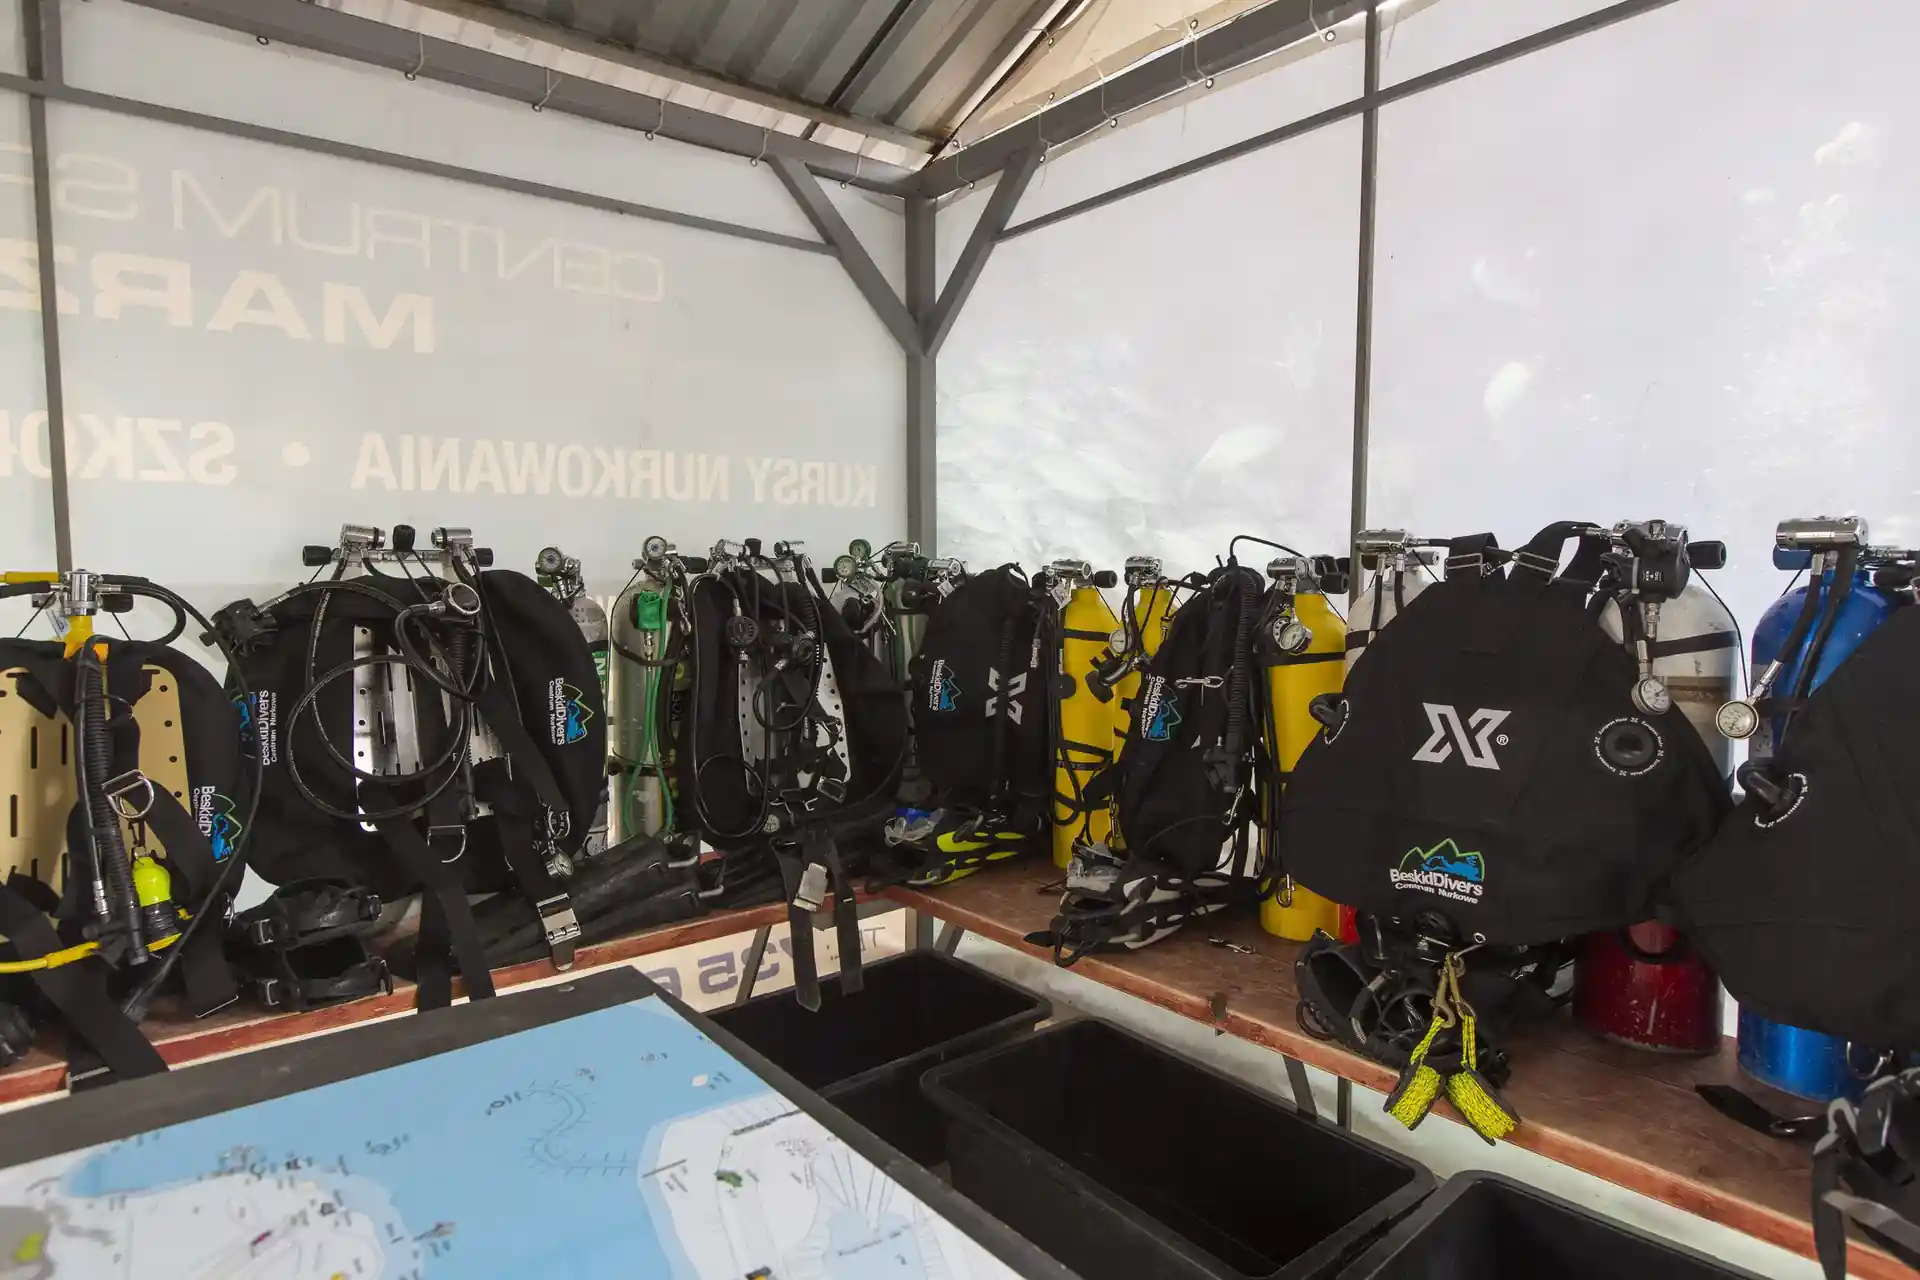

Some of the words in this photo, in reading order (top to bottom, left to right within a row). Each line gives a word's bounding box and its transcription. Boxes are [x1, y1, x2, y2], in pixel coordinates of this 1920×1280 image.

[554, 677, 567, 746] BeskidDivers
[1389, 868, 1484, 897] BeskidDivers
[1395, 882, 1435, 894] Centrum
[1438, 888, 1479, 905] Nurkowe
